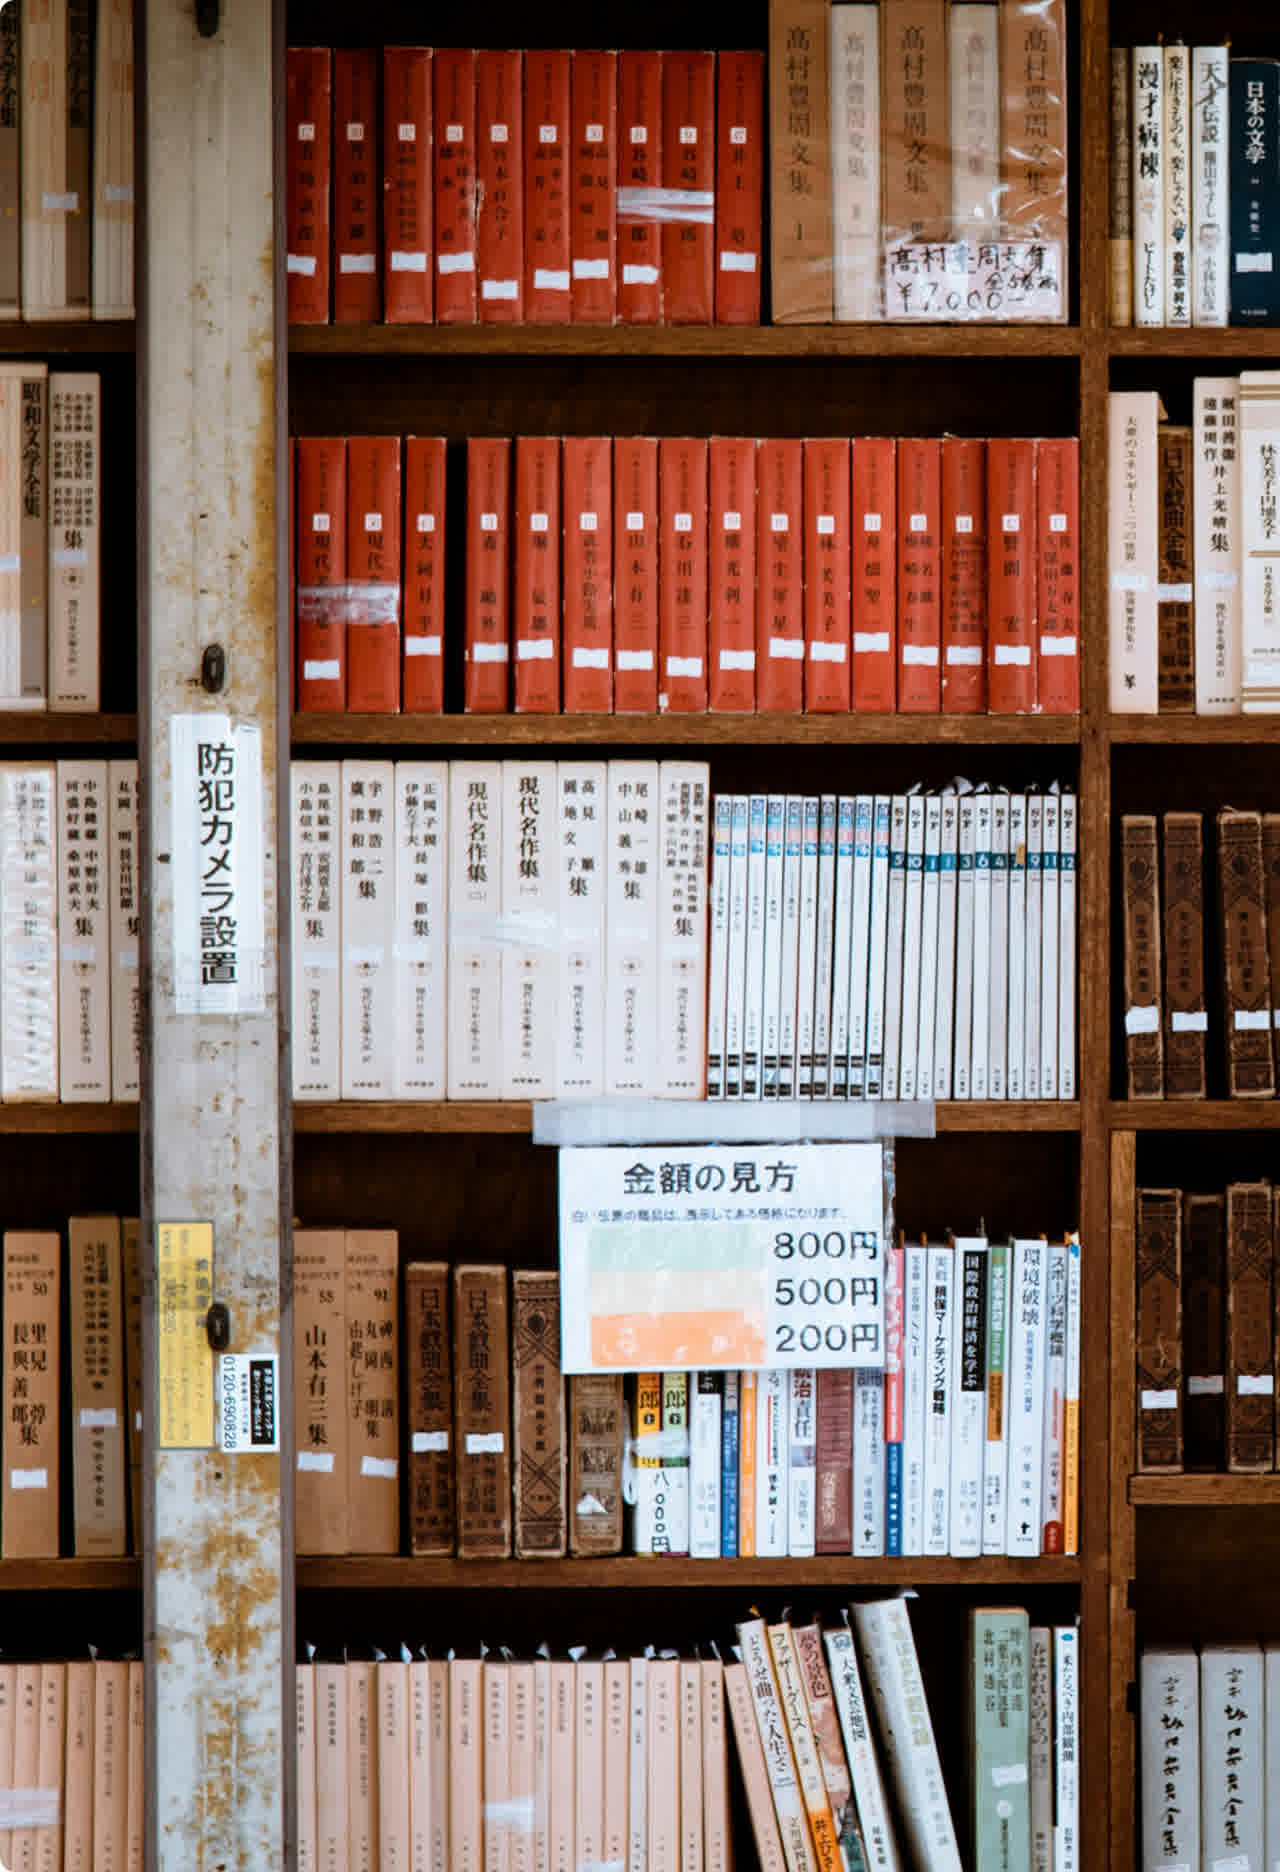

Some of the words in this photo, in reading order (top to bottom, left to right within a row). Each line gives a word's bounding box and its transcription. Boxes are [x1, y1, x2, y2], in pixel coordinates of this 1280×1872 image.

[1138, 62, 1159, 179] 漫才病棟
[1245, 80, 1266, 164] 日本の文学
[1211, 533, 1229, 553] 集
[467, 781, 488, 884] 現代名作集
[519, 776, 541, 880] 現代名作集
[197, 743, 238, 985] 防犯カメラ設置
[358, 880, 376, 899] 集
[569, 876, 588, 897] 集
[623, 880, 641, 900] 集
[74, 918, 94, 937] 集
[305, 918, 324, 939] 集
[413, 918, 431, 937] 集
[675, 917, 694, 937] 集
[623, 1161, 798, 1196] 金額の見方
[773, 1230, 879, 1261] 800円
[774, 1276, 879, 1307] 500円
[1023, 1248, 1040, 1328] 環境破壊
[775, 1322, 881, 1354] 200円
[223, 1356, 237, 1450] 0120-690828
[20, 1425, 39, 1446] 集
[308, 1423, 328, 1446] 集
